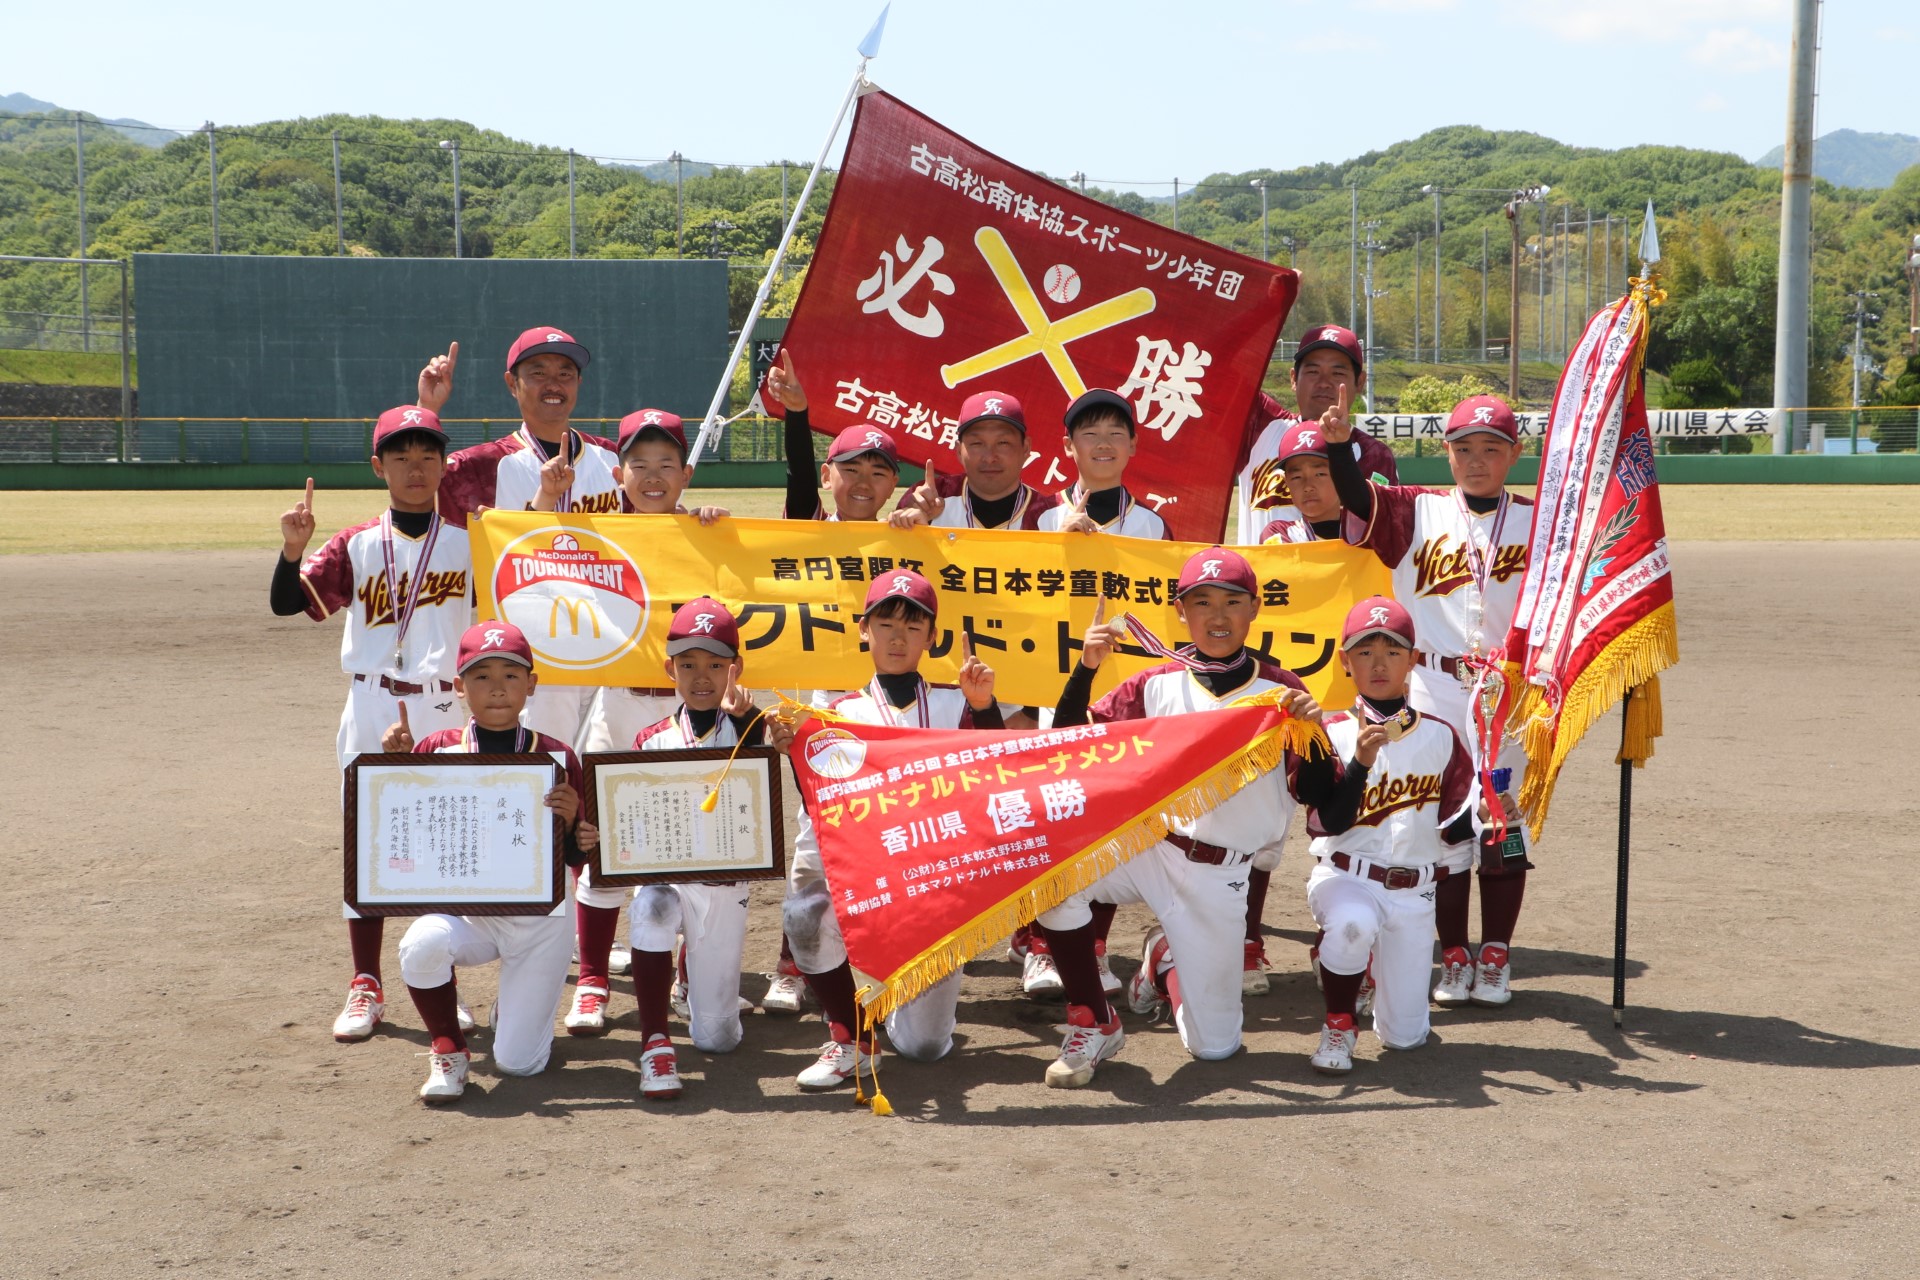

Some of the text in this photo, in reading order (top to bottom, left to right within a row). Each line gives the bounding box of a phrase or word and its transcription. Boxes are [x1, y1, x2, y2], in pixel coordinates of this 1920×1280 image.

[910, 142, 1244, 301] 古高松南体協スポーツ少年団
[856, 234, 1212, 441] 必 勝
[1589, 471, 1604, 498] 優勝
[512, 557, 624, 592] TOURNAMENT
[538, 551, 595, 561] McDonald's
[940, 562, 1290, 607] 全日本学童軟式会
[816, 723, 1108, 803] 高円宮賜杯 第45回 全日本学童軟式野球大会
[820, 734, 1156, 829] マクドナルド・トーナメント
[511, 808, 527, 848] 賞状
[643, 791, 651, 846] ここに表彰します
[652, 791, 663, 861] 収められましたので
[672, 790, 683, 860] の練習の成果を十分
[682, 789, 693, 858] あなたのチームは日頃
[738, 803, 750, 834] 賞状
[880, 778, 1087, 857] 香川県 優勝
[847, 851, 1052, 917] 特別協賛 日本マクドナルド株式会社
